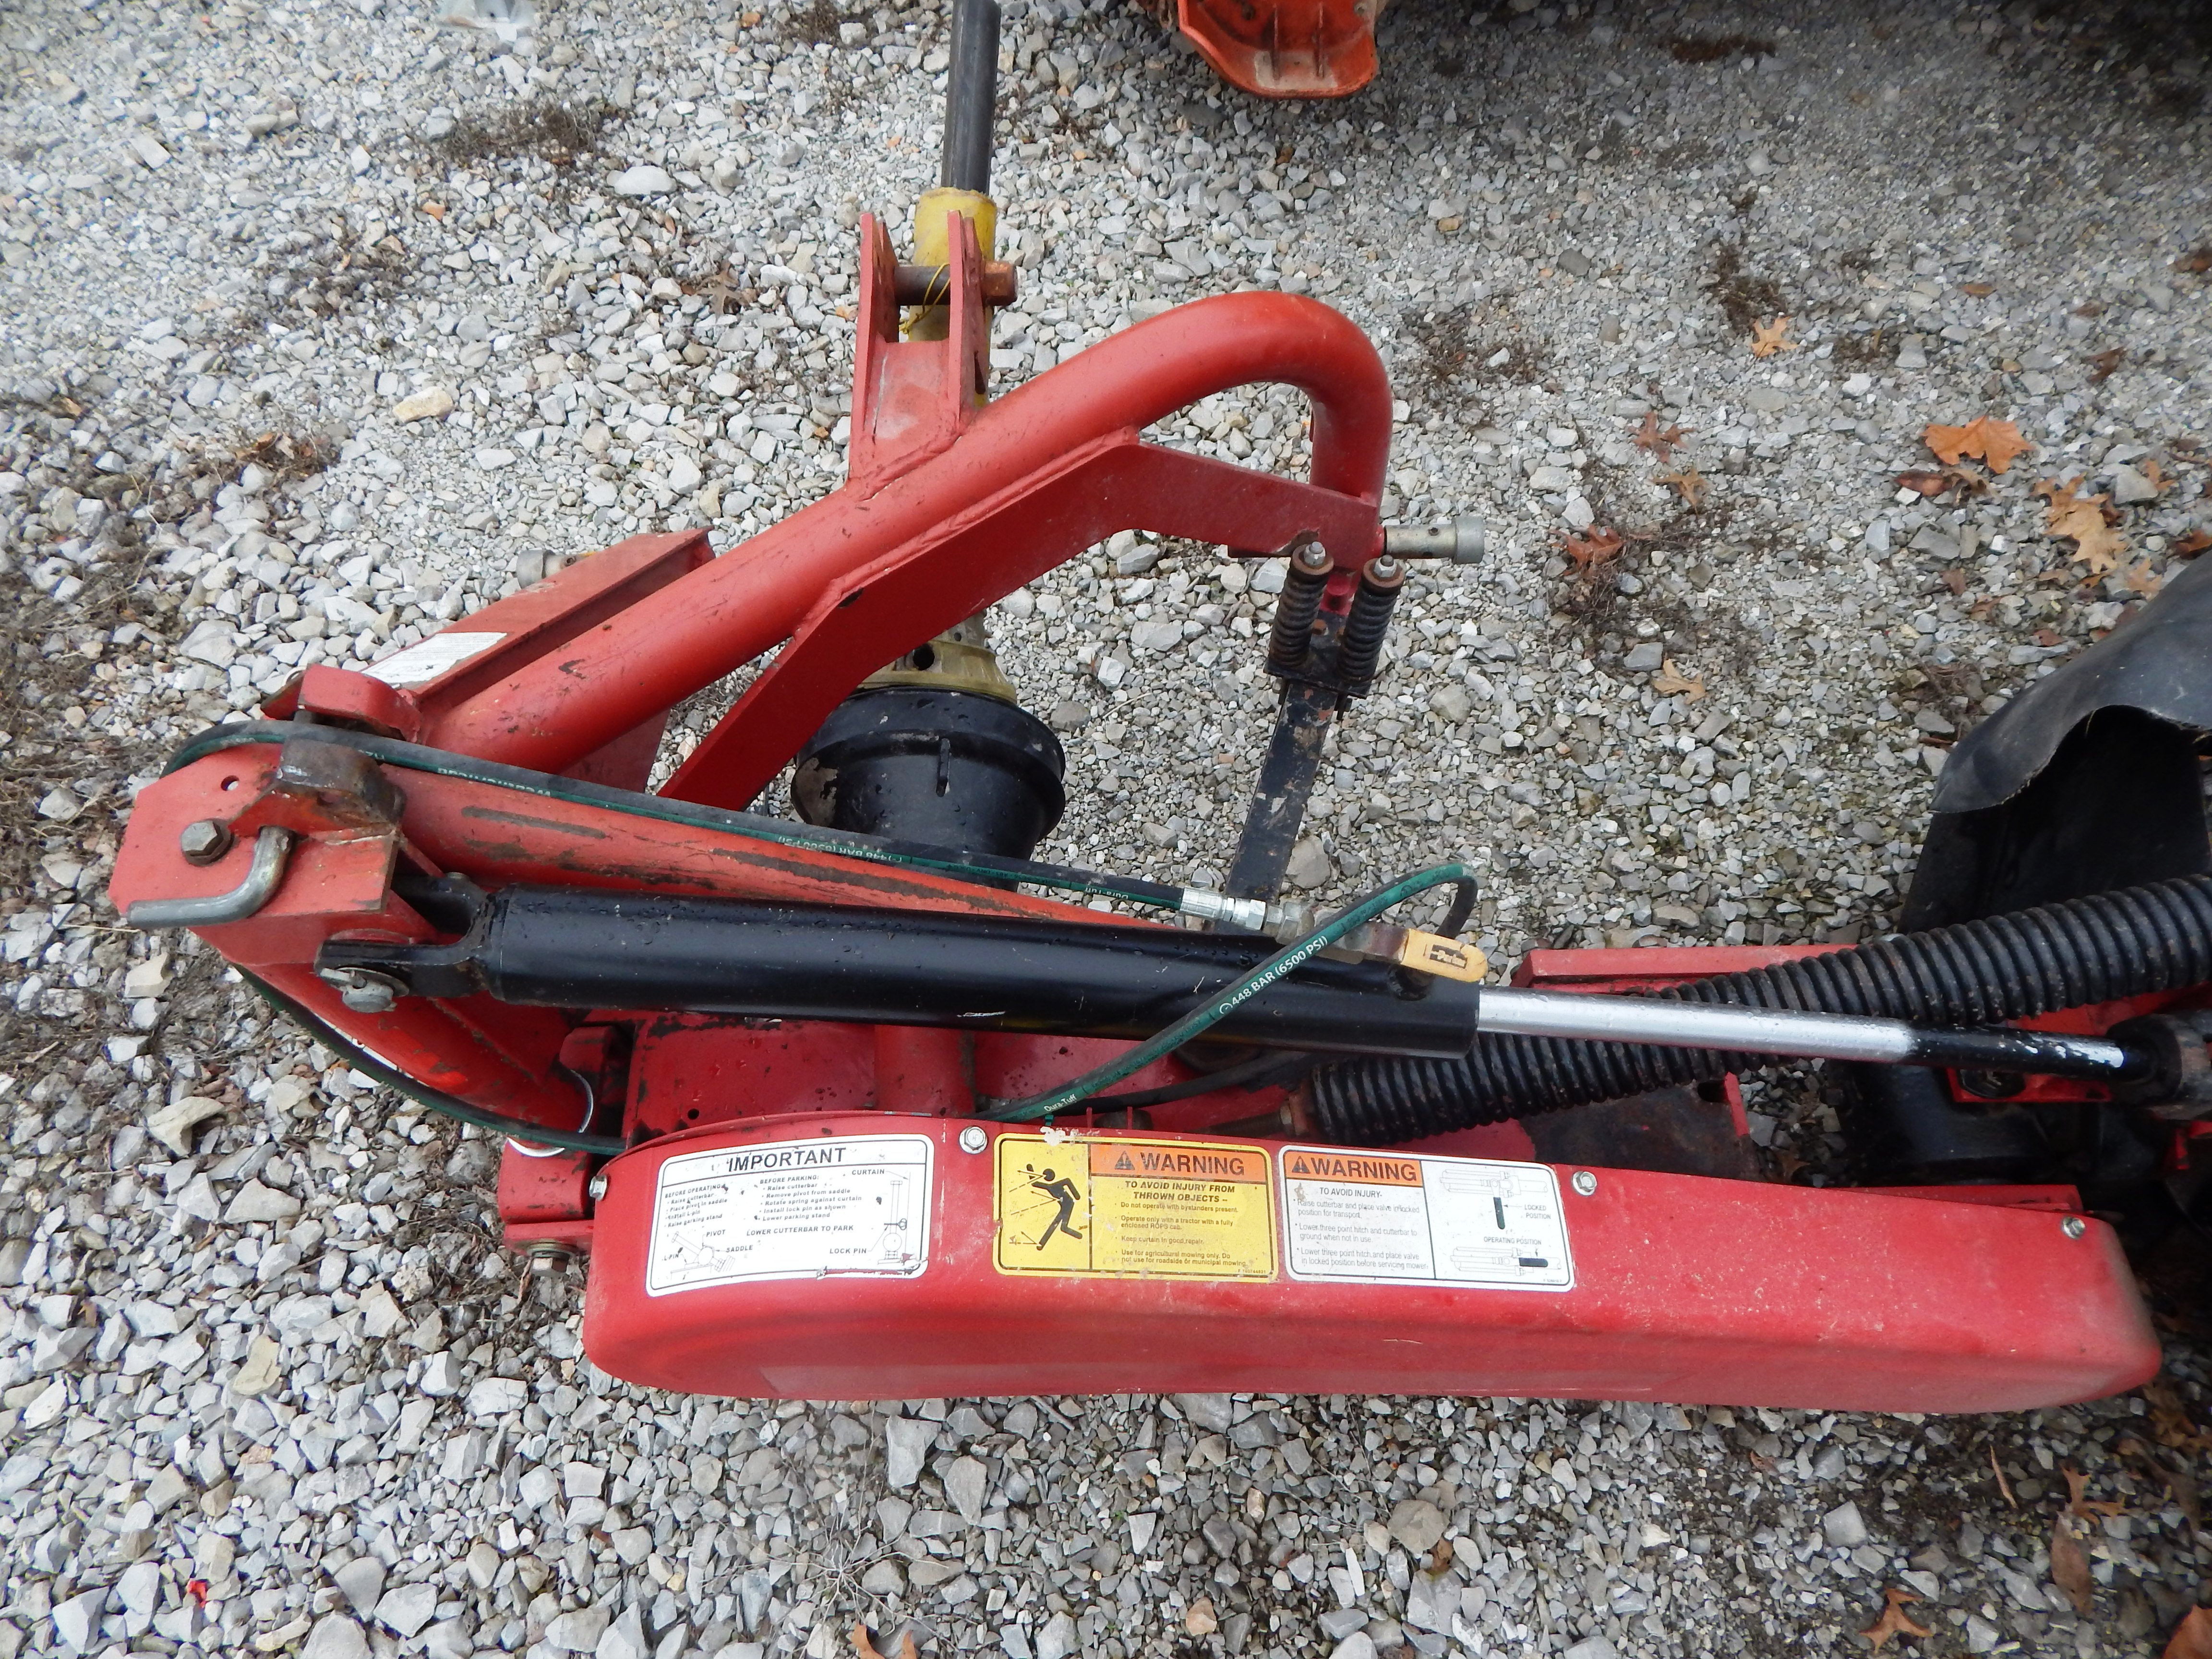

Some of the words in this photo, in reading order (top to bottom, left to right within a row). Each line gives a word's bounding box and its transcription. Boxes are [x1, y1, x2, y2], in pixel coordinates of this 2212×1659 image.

[1232, 988, 1252, 1005] 448
[1251, 972, 1275, 991] BAR
[1275, 950, 1306, 975] (6500
[1306, 936, 1328, 954] PSI)
[1044, 1094, 1077, 1111] Dura-Tuff
[728, 1147, 846, 1172] IMPORTANT
[1141, 1152, 1245, 1176] WARNING
[1310, 1157, 1418, 1181] WARNING
[1172, 1182, 1206, 1191] INJURY
[1209, 1185, 1235, 1193] FROM
[1331, 1188, 1353, 1196] AVOID
[665, 1190, 686, 1198] BEFORE
[1133, 1191, 1175, 1200] THROWN
[1178, 1193, 1220, 1202] OBJECTS
[1298, 1208, 1322, 1216] position
[773, 1226, 818, 1234] CUTTERBAR
[1320, 1224, 1335, 1232] three
[1121, 1235, 1137, 1243] Keep
[1300, 1233, 1322, 1241] ground
[1301, 1247, 1320, 1255] Lower
[1322, 1248, 1338, 1256] three
[1339, 1249, 1355, 1257] point
[1356, 1249, 1371, 1257] hitch
[1385, 1251, 1402, 1260] place
[1331, 1259, 1355, 1267] position
[1378, 1261, 1405, 1270] servicing
